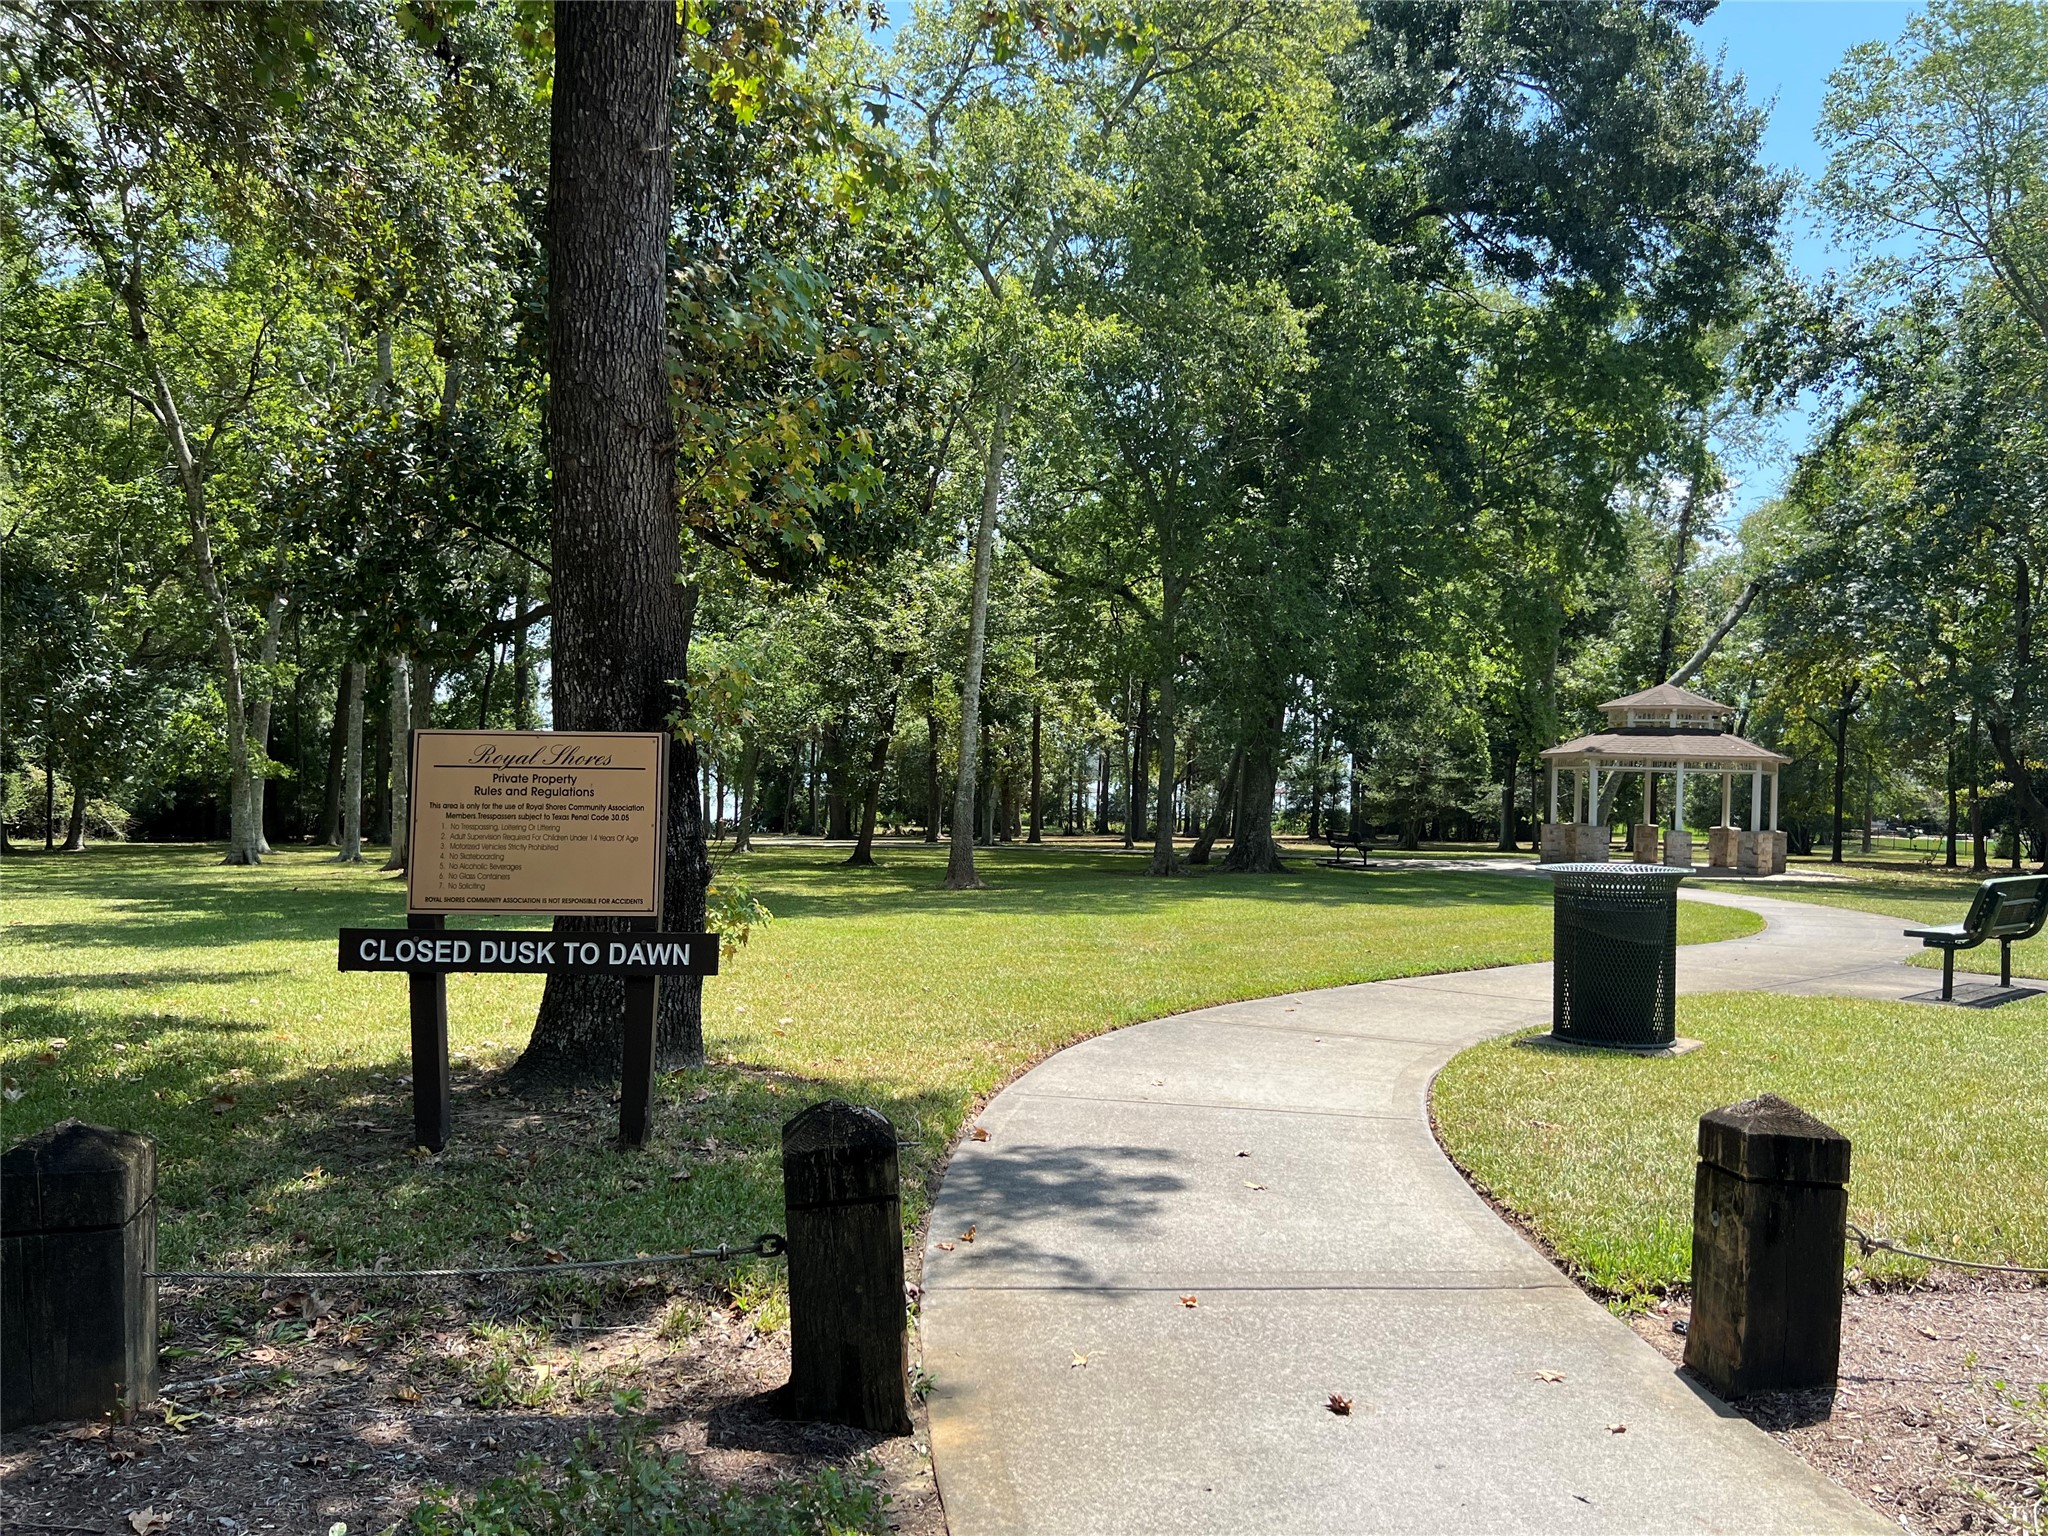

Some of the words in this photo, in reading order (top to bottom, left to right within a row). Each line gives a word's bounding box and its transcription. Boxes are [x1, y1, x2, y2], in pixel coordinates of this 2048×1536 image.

[468, 744, 547, 771] Royal
[542, 744, 612, 766] Shores
[493, 774, 528, 783] Private
[532, 774, 577, 785] Property
[474, 786, 502, 796] Rules
[506, 787, 527, 796] and
[531, 787, 594, 798] Regulations
[526, 803, 544, 811] Royal
[568, 804, 606, 812] Community
[518, 813, 542, 821] subject
[501, 824, 526, 832] Loitering
[537, 824, 560, 832] Littering
[459, 883, 485, 891] Soliciting
[359, 939, 471, 963] CLOSED
[479, 941, 555, 964] DUSK
[564, 942, 600, 964] TO
[609, 943, 690, 966] DAWN
